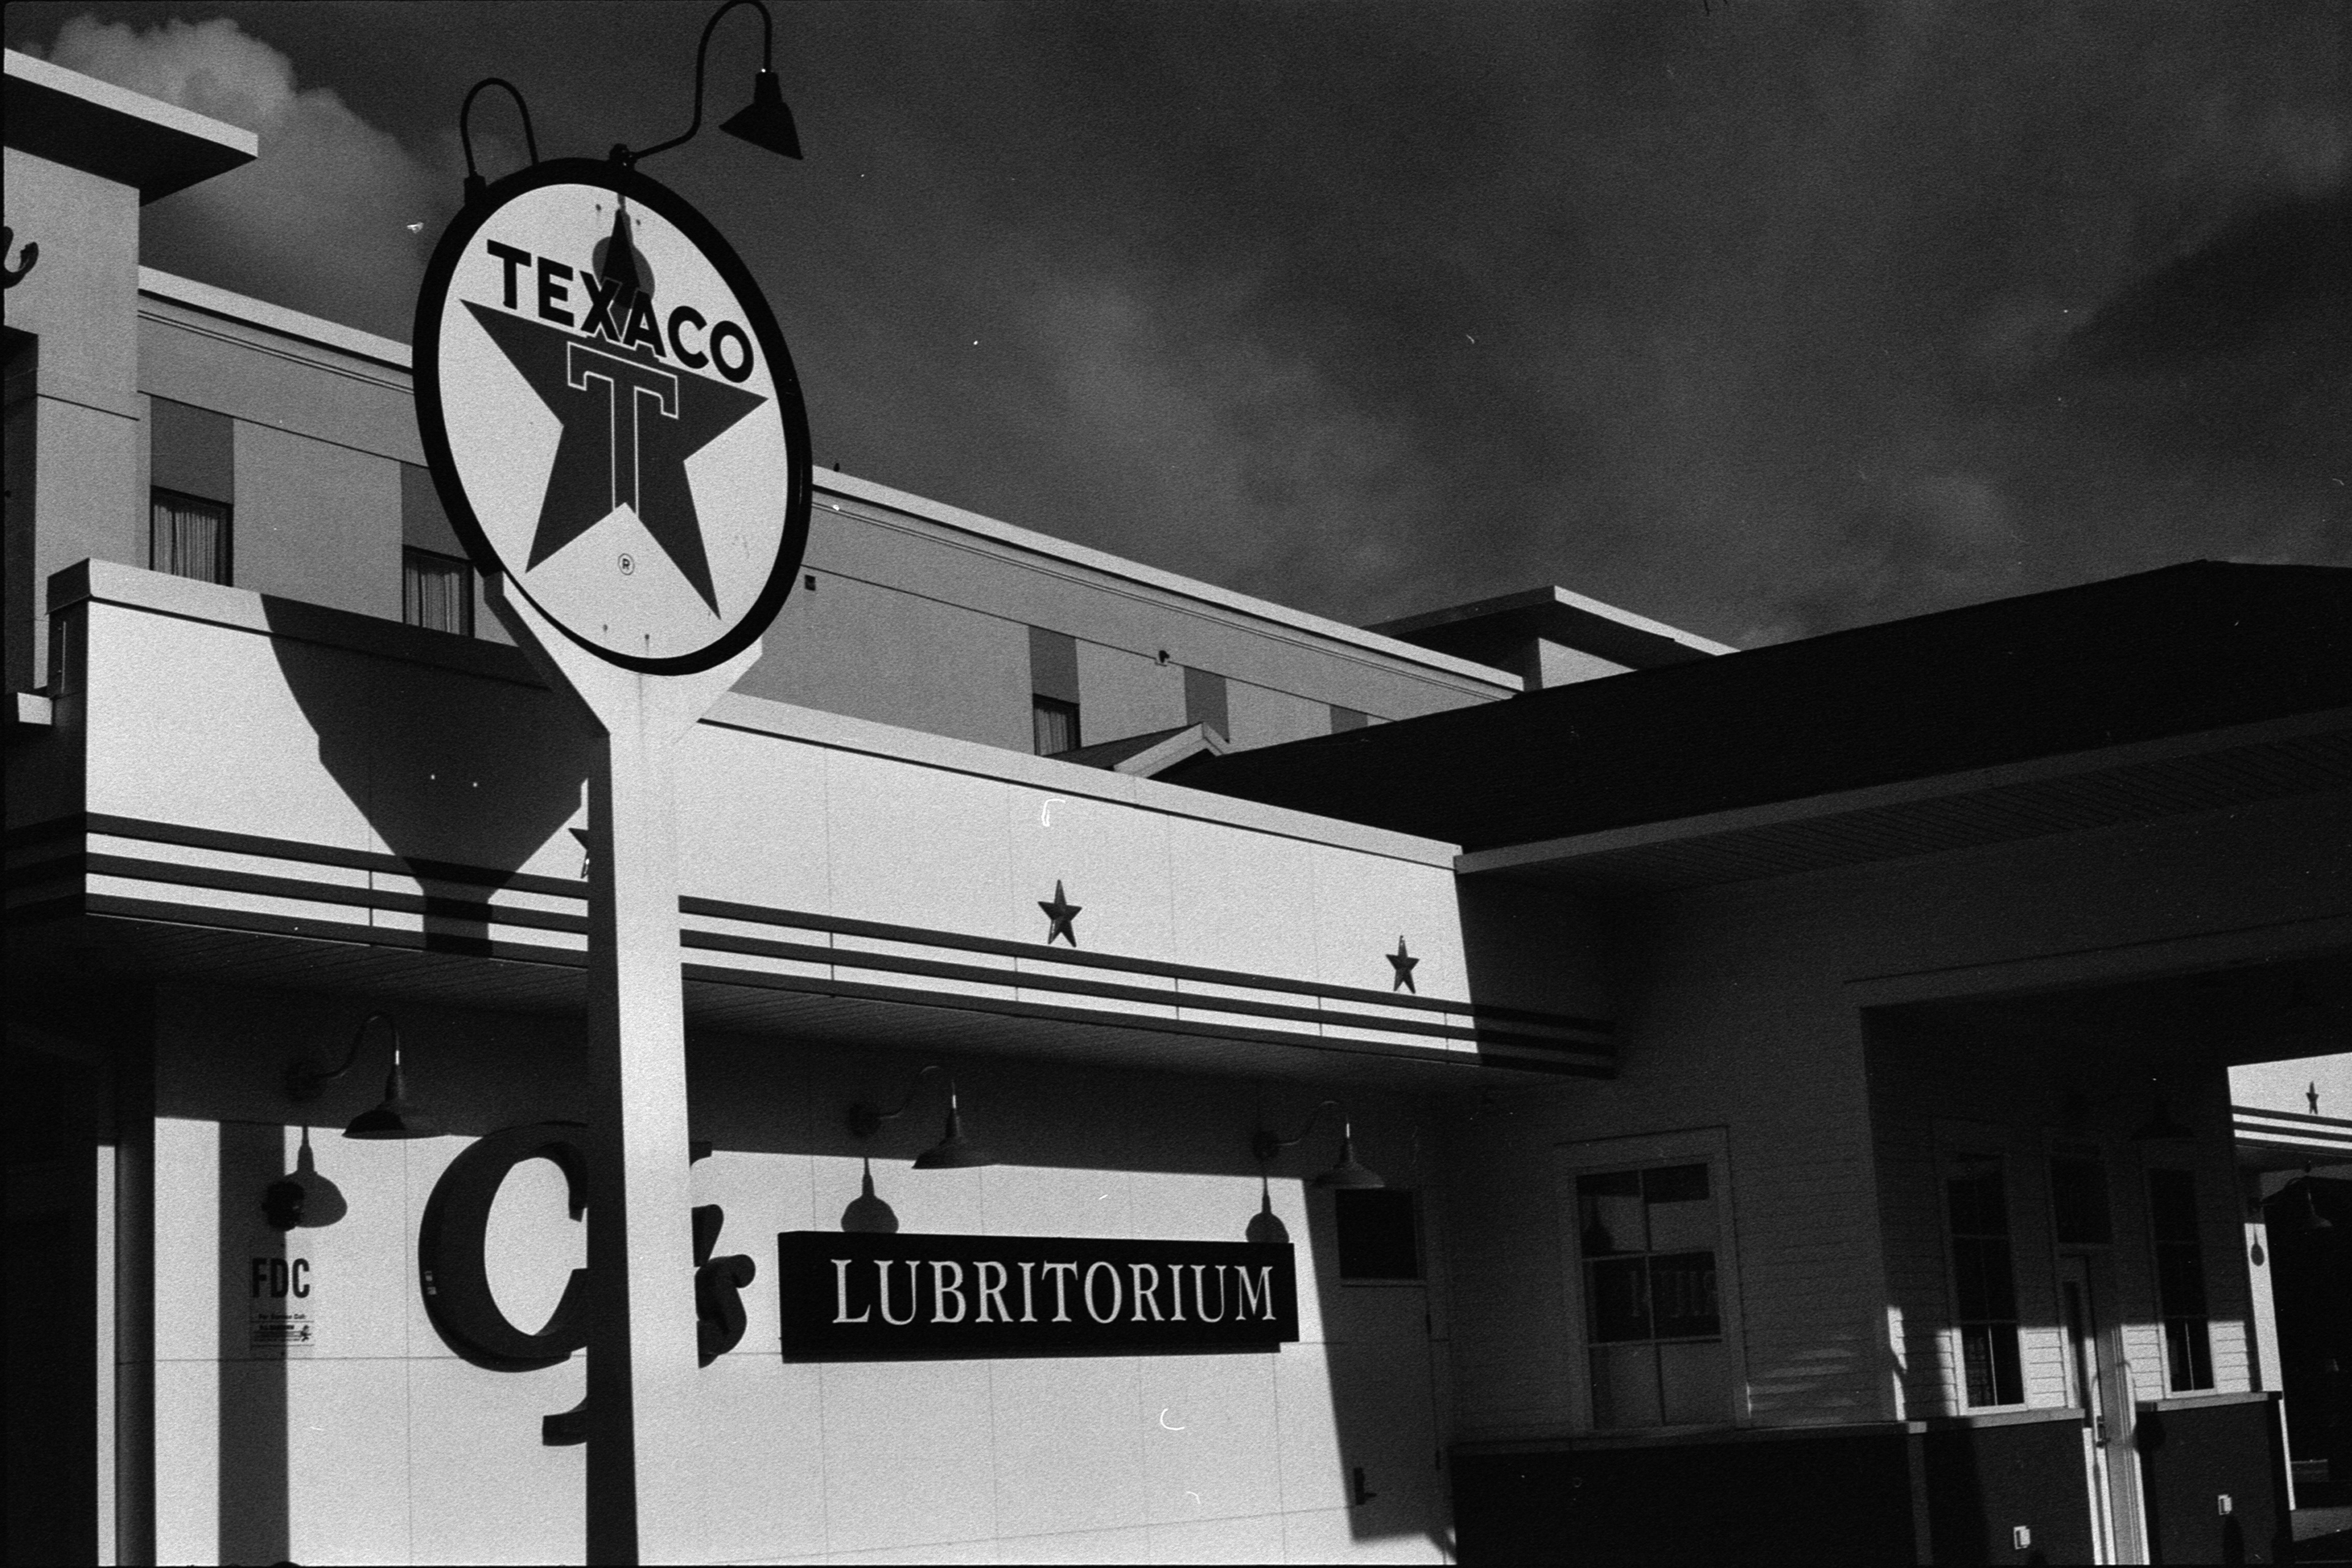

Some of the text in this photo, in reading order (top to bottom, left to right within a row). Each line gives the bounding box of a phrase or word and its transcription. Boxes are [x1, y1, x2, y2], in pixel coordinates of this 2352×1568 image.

[487, 238, 755, 383] TEXACO
[252, 1257, 311, 1298] FDC
[831, 1258, 1277, 1325] LUBRITORIUM
